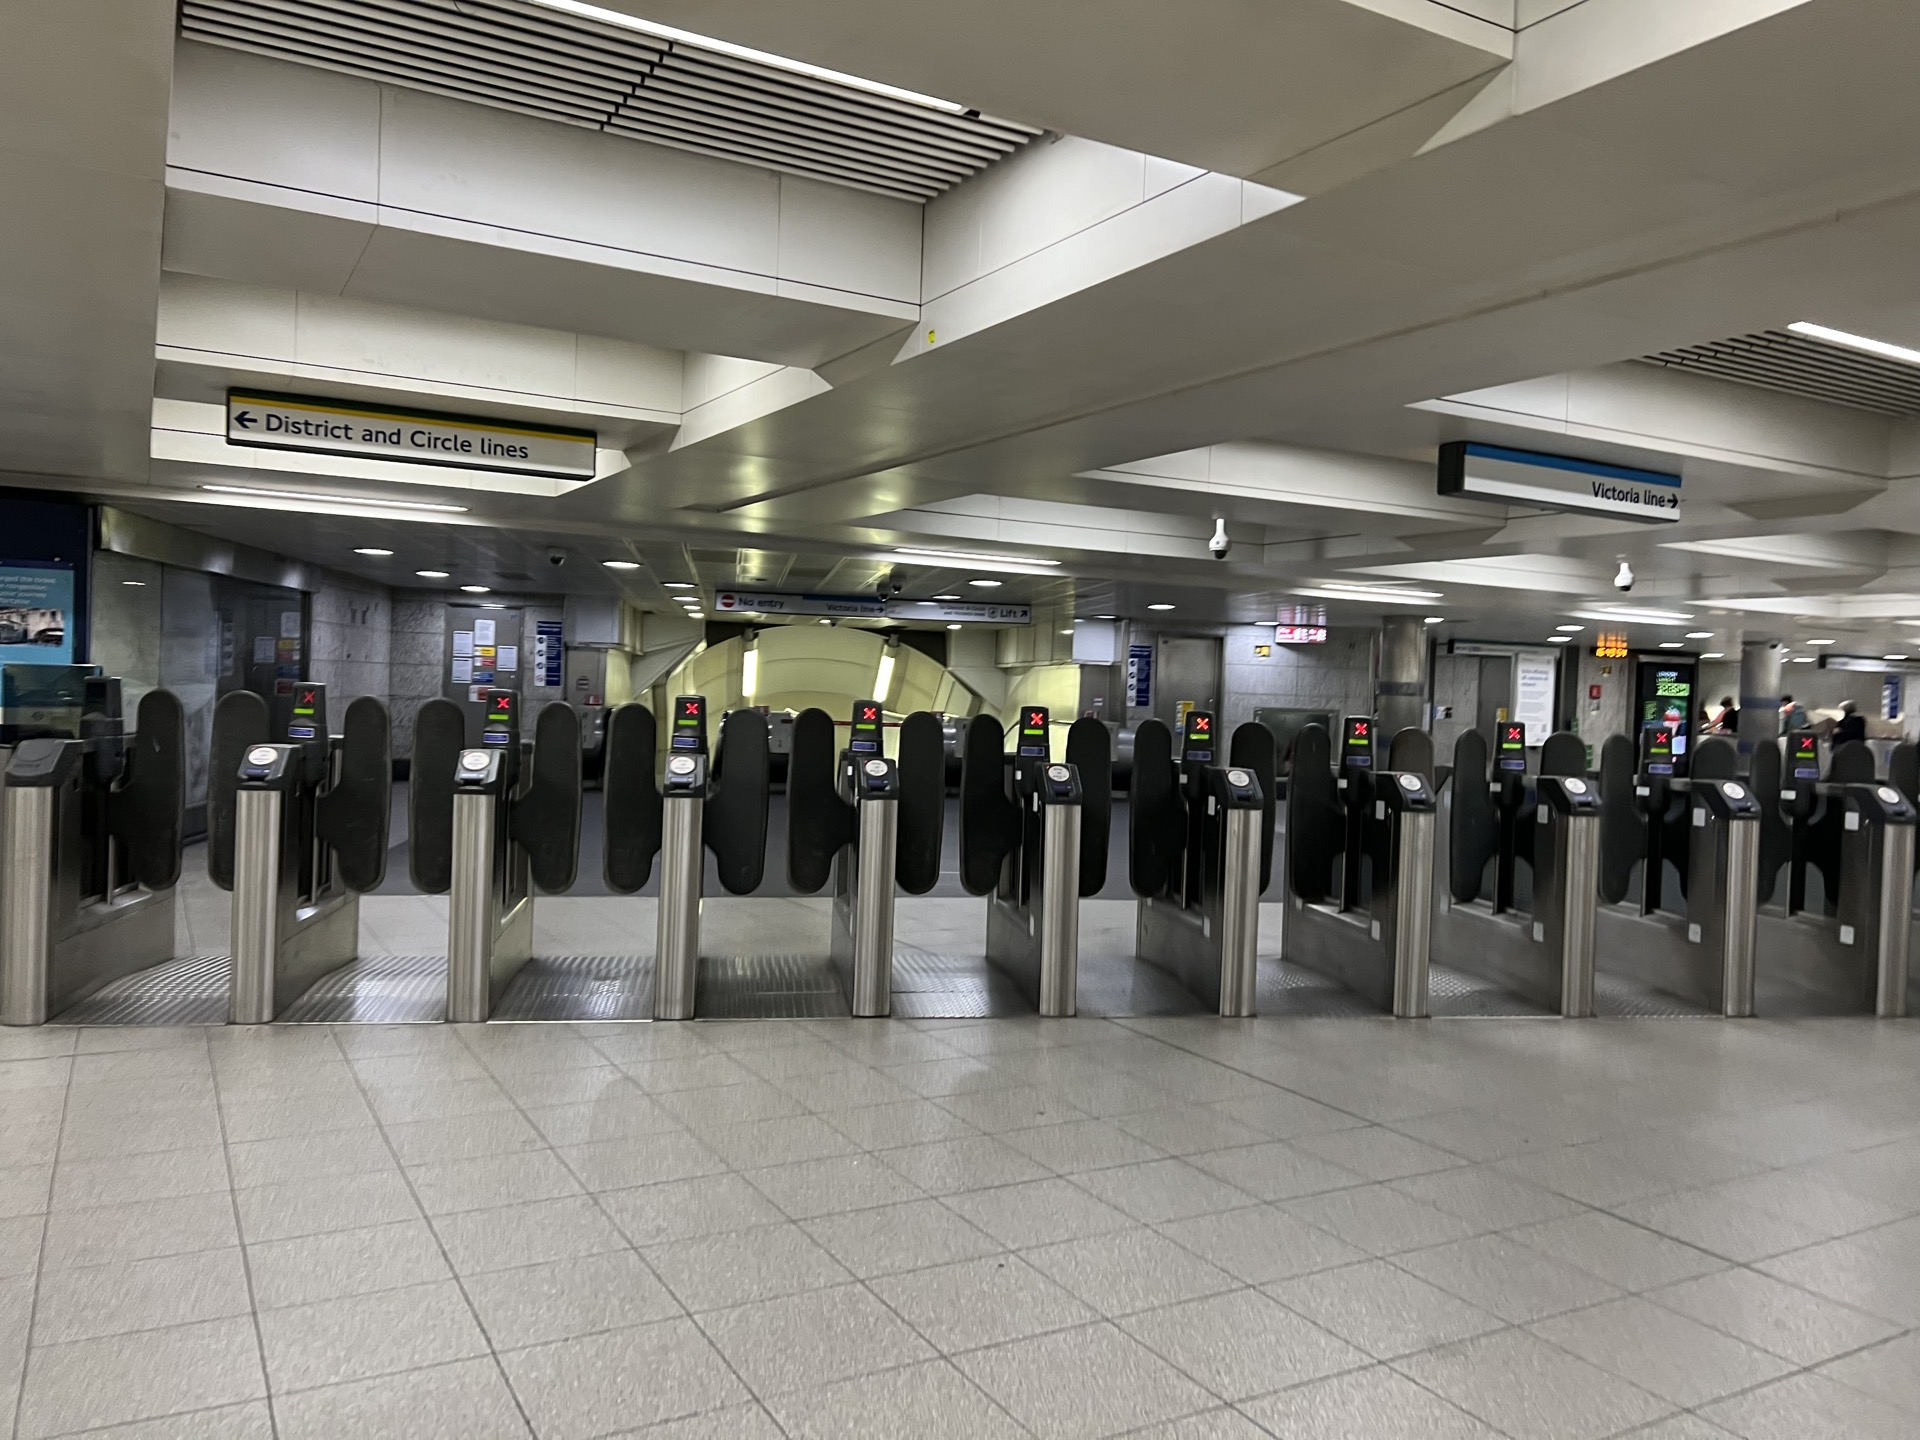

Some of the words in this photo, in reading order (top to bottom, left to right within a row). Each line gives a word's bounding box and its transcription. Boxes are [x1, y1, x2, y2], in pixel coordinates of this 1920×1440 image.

[265, 413, 353, 441] District
[361, 427, 401, 445] and
[410, 430, 472, 453] Circle
[480, 438, 529, 459] lines
[1592, 481, 1640, 504] Victoria
[1643, 489, 1666, 507] line
[738, 597, 753, 607] No
[757, 600, 784, 609] entry
[826, 604, 858, 613] Victoria
[860, 605, 875, 613] line
[1000, 608, 1018, 618] Lift
